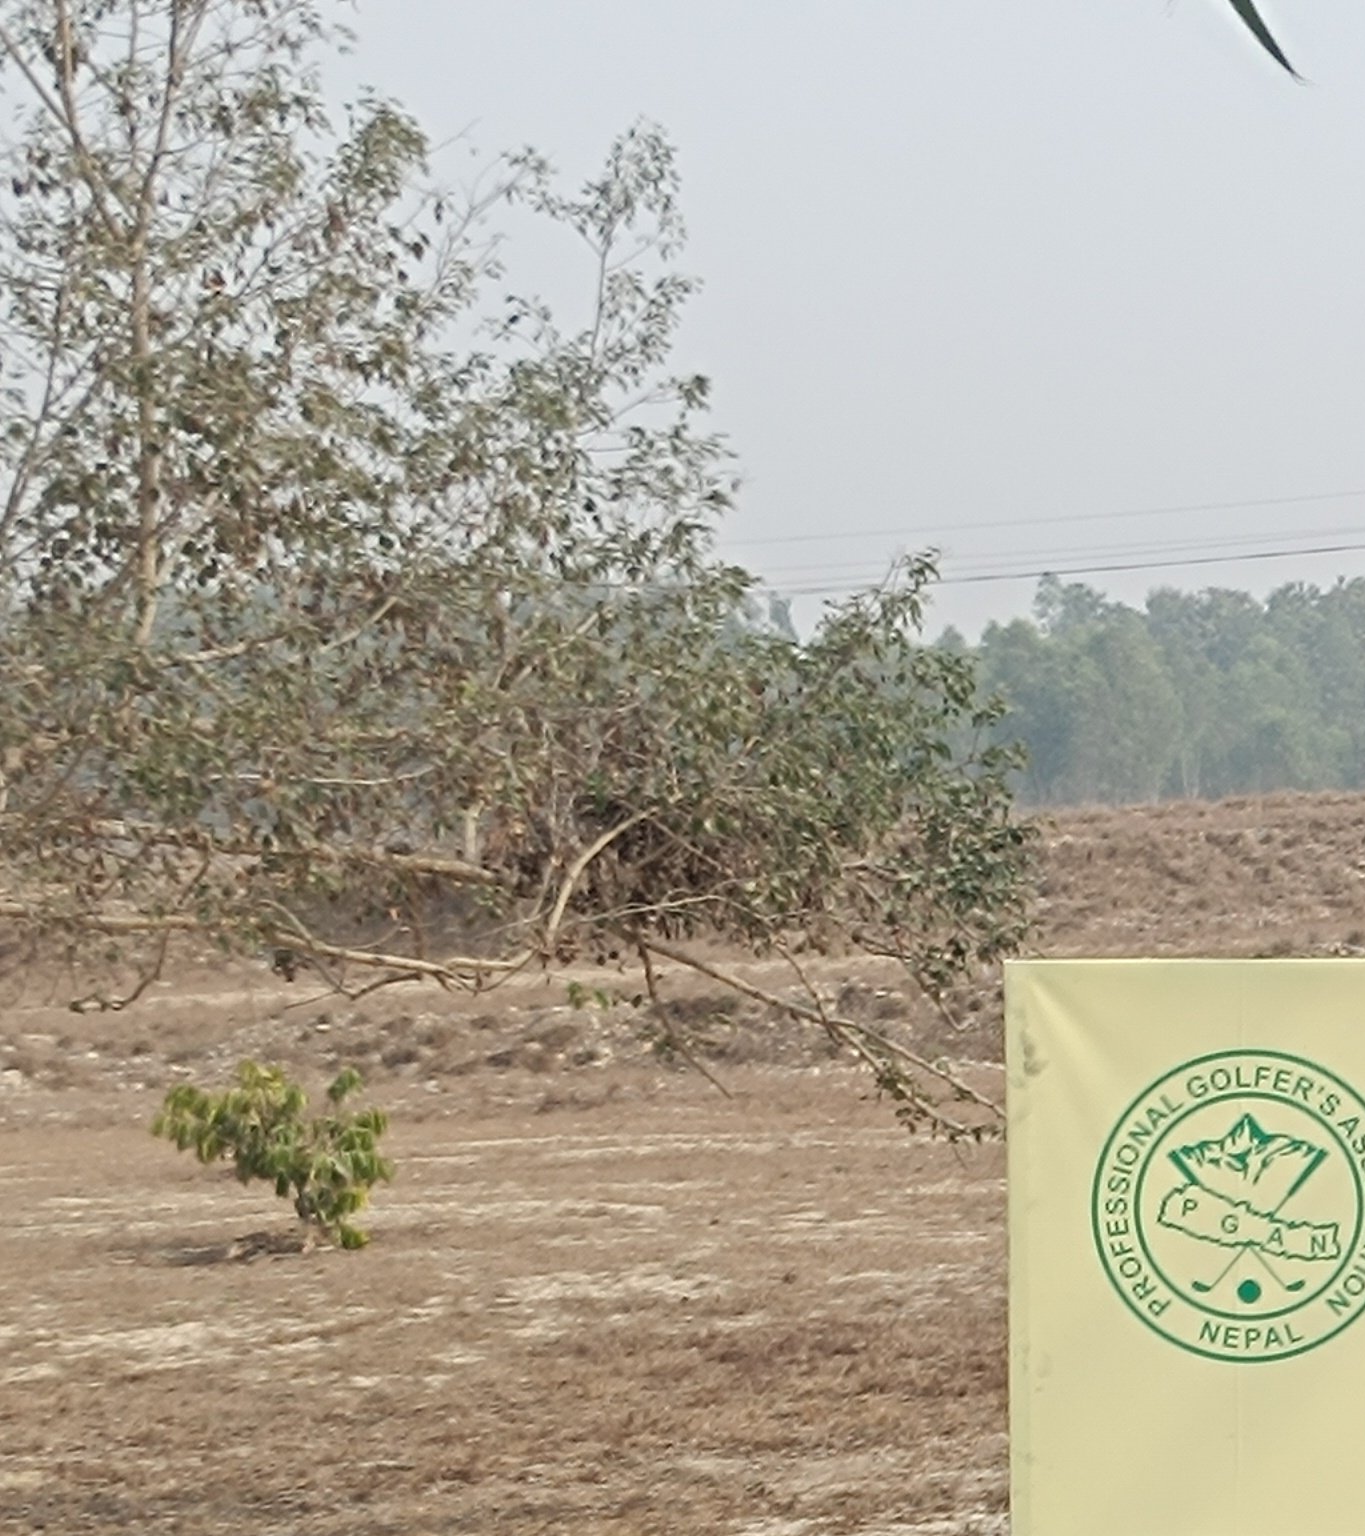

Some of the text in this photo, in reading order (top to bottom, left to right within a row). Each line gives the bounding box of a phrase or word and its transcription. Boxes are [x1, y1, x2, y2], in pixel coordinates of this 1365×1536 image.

[1105, 1094, 1185, 1317] PROFESSIONAL
[1186, 1066, 1341, 1117] GOLFER'S
[1199, 1320, 1305, 1349] NEPAL
